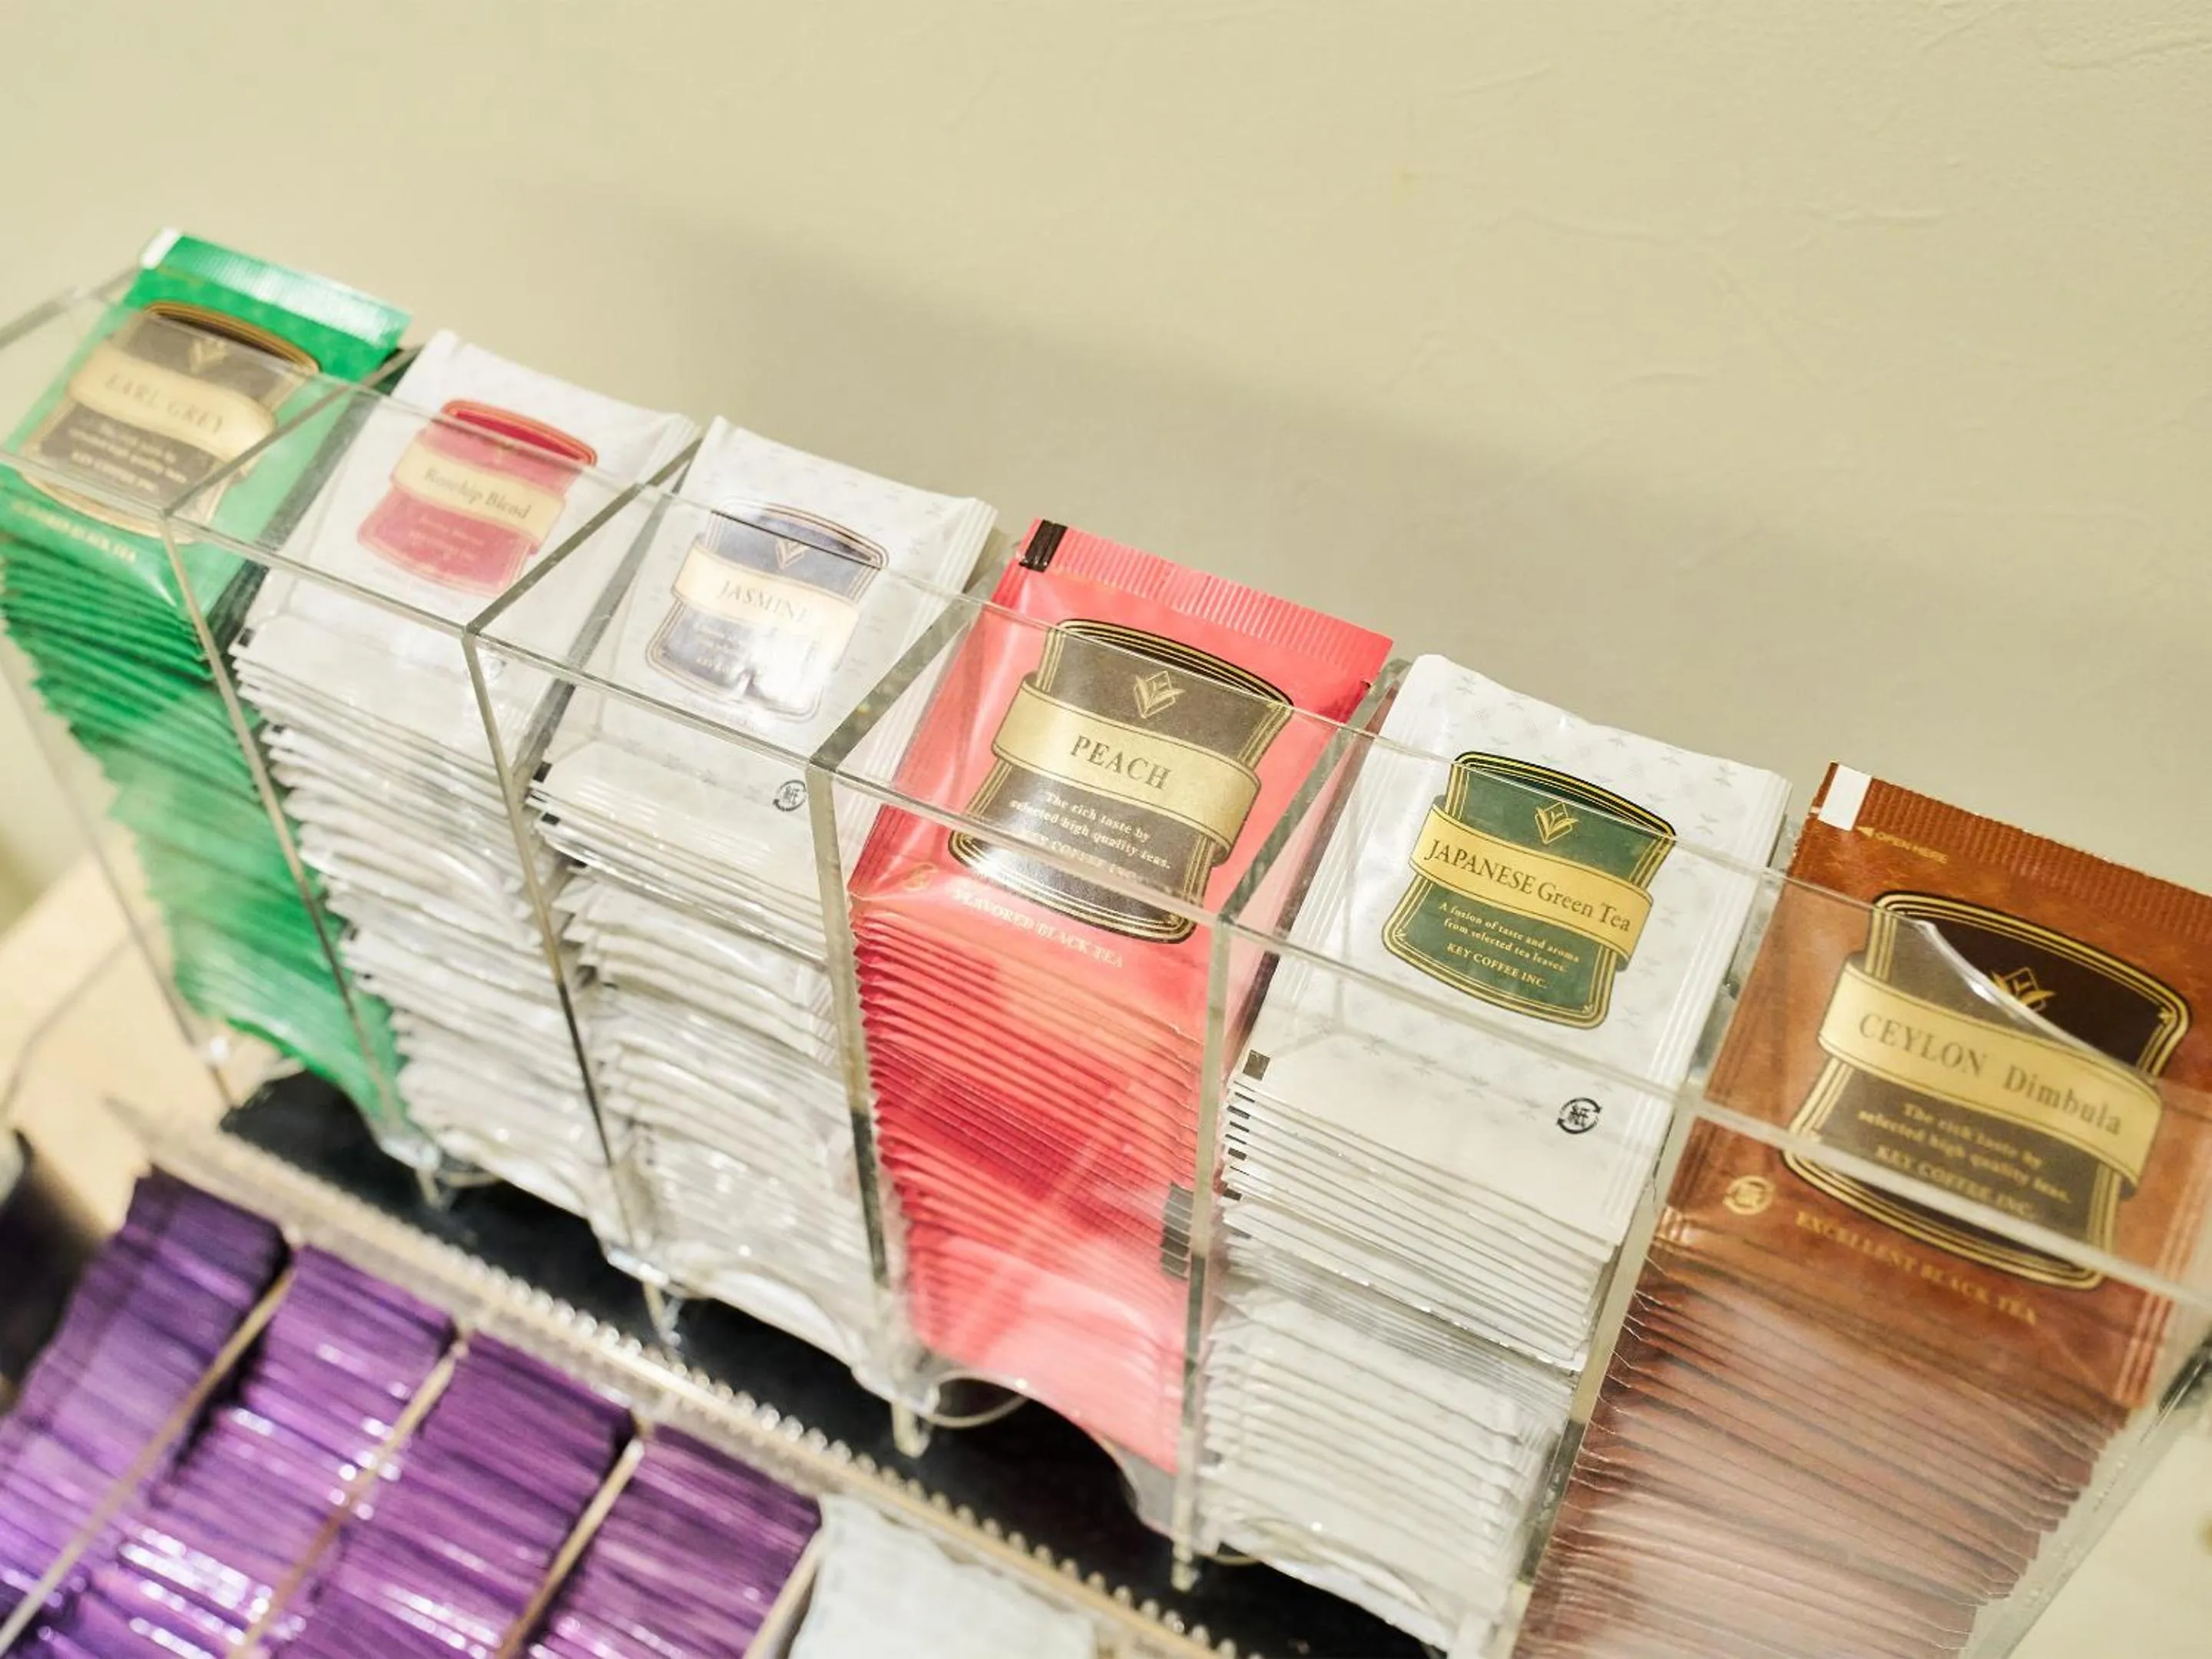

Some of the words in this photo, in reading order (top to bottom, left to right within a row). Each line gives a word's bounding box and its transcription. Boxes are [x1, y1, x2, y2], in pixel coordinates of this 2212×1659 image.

[104, 373, 161, 410] EARL
[167, 400, 223, 435] GREY
[485, 491, 532, 519] Blend
[1070, 735, 1172, 790] PEACH
[1009, 799, 1058, 824] selected
[1059, 816, 1089, 837] high
[1092, 830, 1138, 857] quality
[1140, 848, 1171, 869] teas.
[1045, 791, 1068, 809] The
[1071, 802, 1097, 821] rich
[1098, 813, 1132, 834] taste
[1134, 825, 1151, 843] by
[1875, 830, 1912, 850] OPEN
[1912, 843, 1948, 864] HERE
[1424, 839, 1537, 895] JAPANESE
[1537, 881, 1594, 918] Green
[1598, 901, 1631, 932] Tea
[953, 888, 1035, 932] FLAVORED
[1037, 922, 1088, 955] BLACK
[1094, 942, 1123, 969] TEA
[1439, 902, 1448, 912] A
[1450, 905, 1483, 925] fusion
[1485, 920, 1498, 930] of
[1498, 926, 1524, 941] taste
[1525, 935, 1547, 950] and
[1547, 945, 1579, 963] aroma
[1444, 917, 1469, 935] from
[1471, 930, 1513, 952] selected
[1514, 946, 1531, 959] tea
[1446, 942, 1472, 959] KEY
[1473, 952, 1520, 977] COFFEE
[1521, 972, 1548, 989] INC.
[1859, 1012, 1988, 1078] CEYLON
[2002, 1064, 2123, 1136] Dimbula
[1796, 1210, 1918, 1273] EXCELLENT
[1920, 1260, 1991, 1304] BLACK
[1998, 1296, 2038, 1326] TEA
